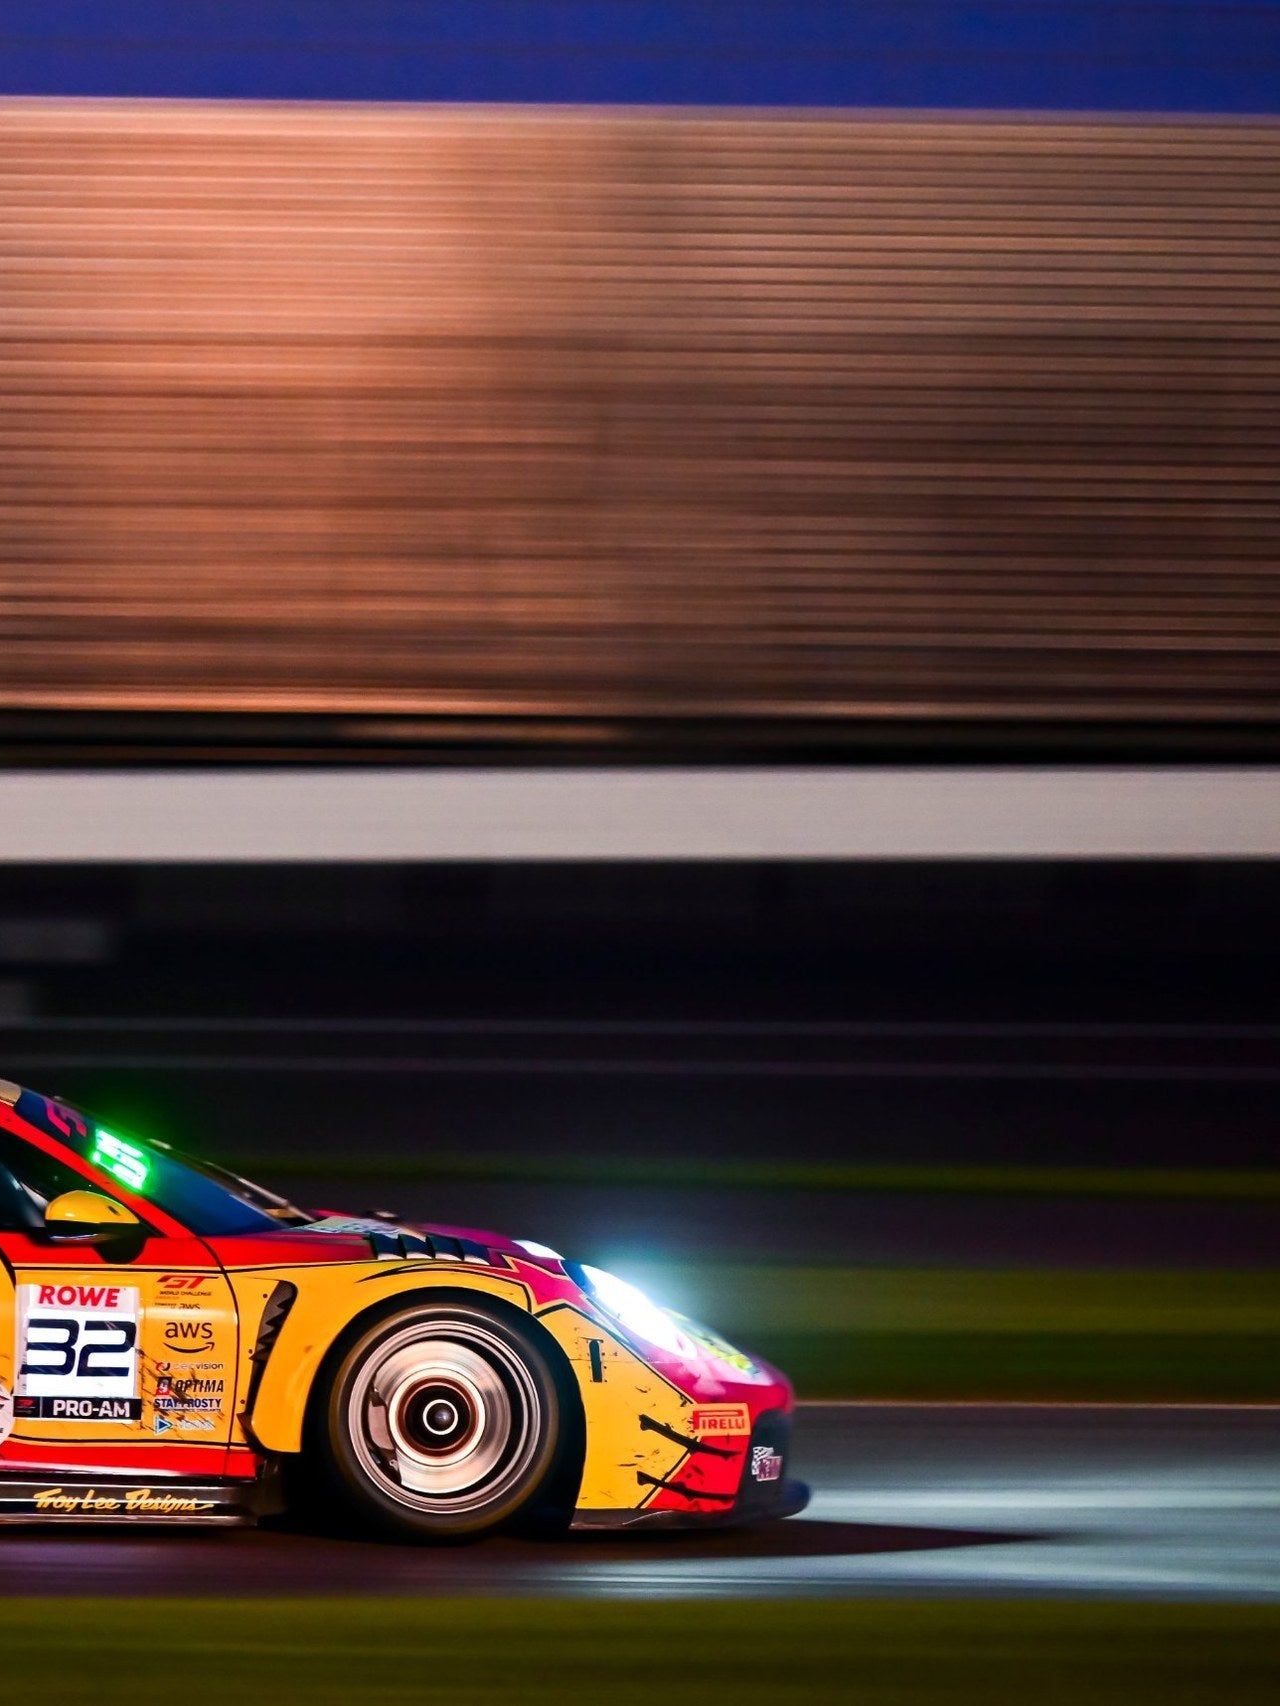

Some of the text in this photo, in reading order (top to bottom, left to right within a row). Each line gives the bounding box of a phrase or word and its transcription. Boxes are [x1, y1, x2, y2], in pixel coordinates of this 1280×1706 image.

[38, 1285, 120, 1308] ROWE
[165, 1322, 213, 1339] aws
[20, 1318, 137, 1377] 32
[175, 1379, 224, 1393] OPTIMA
[53, 1400, 131, 1418] PRO-AM
[181, 1398, 222, 1408] ROSTY
[692, 1410, 746, 1431] PIRELLI
[33, 1488, 215, 1513] Troy Lee Designs
